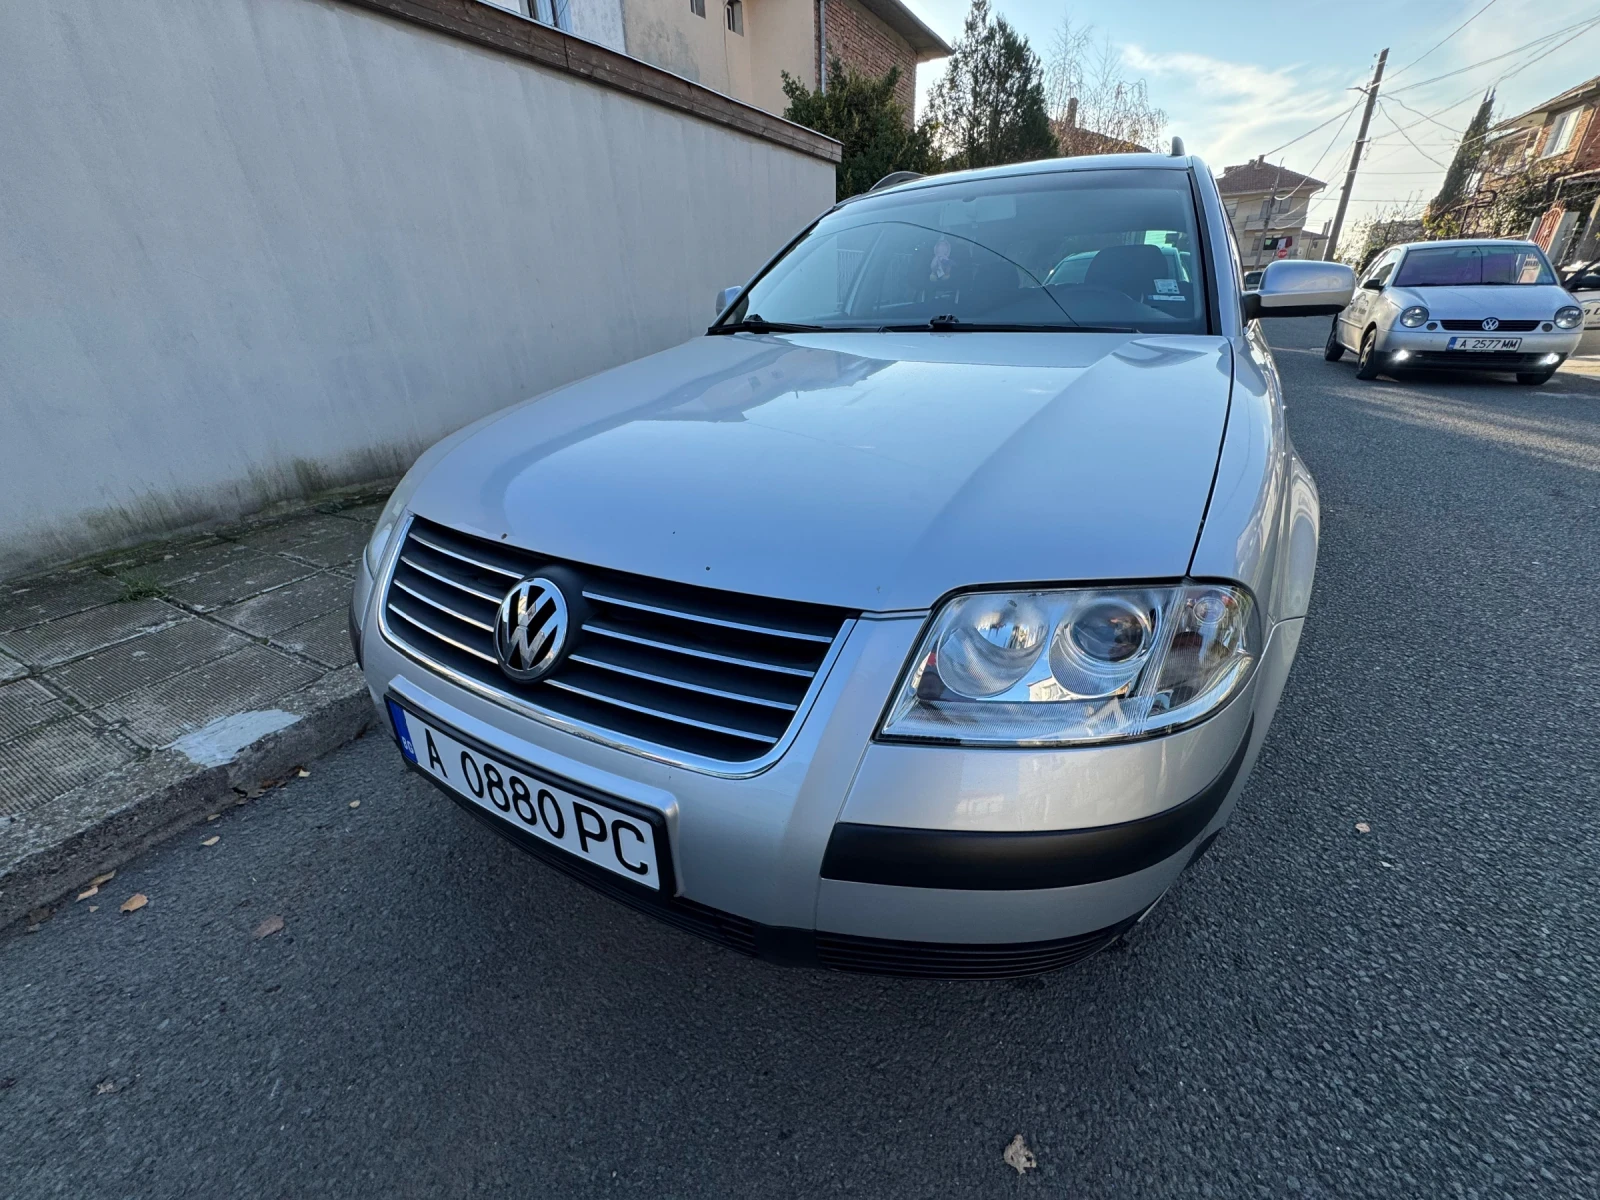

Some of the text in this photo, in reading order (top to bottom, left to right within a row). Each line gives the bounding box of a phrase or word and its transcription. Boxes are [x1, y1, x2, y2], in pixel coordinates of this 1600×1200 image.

[1482, 318, 1499, 331] VW
[1459, 339, 1467, 348] A
[1472, 339, 1501, 349] 2577
[1501, 339, 1519, 349] MM
[495, 577, 568, 680] VW
[401, 735, 414, 755] BG
[425, 727, 649, 875] A 0880 PC
